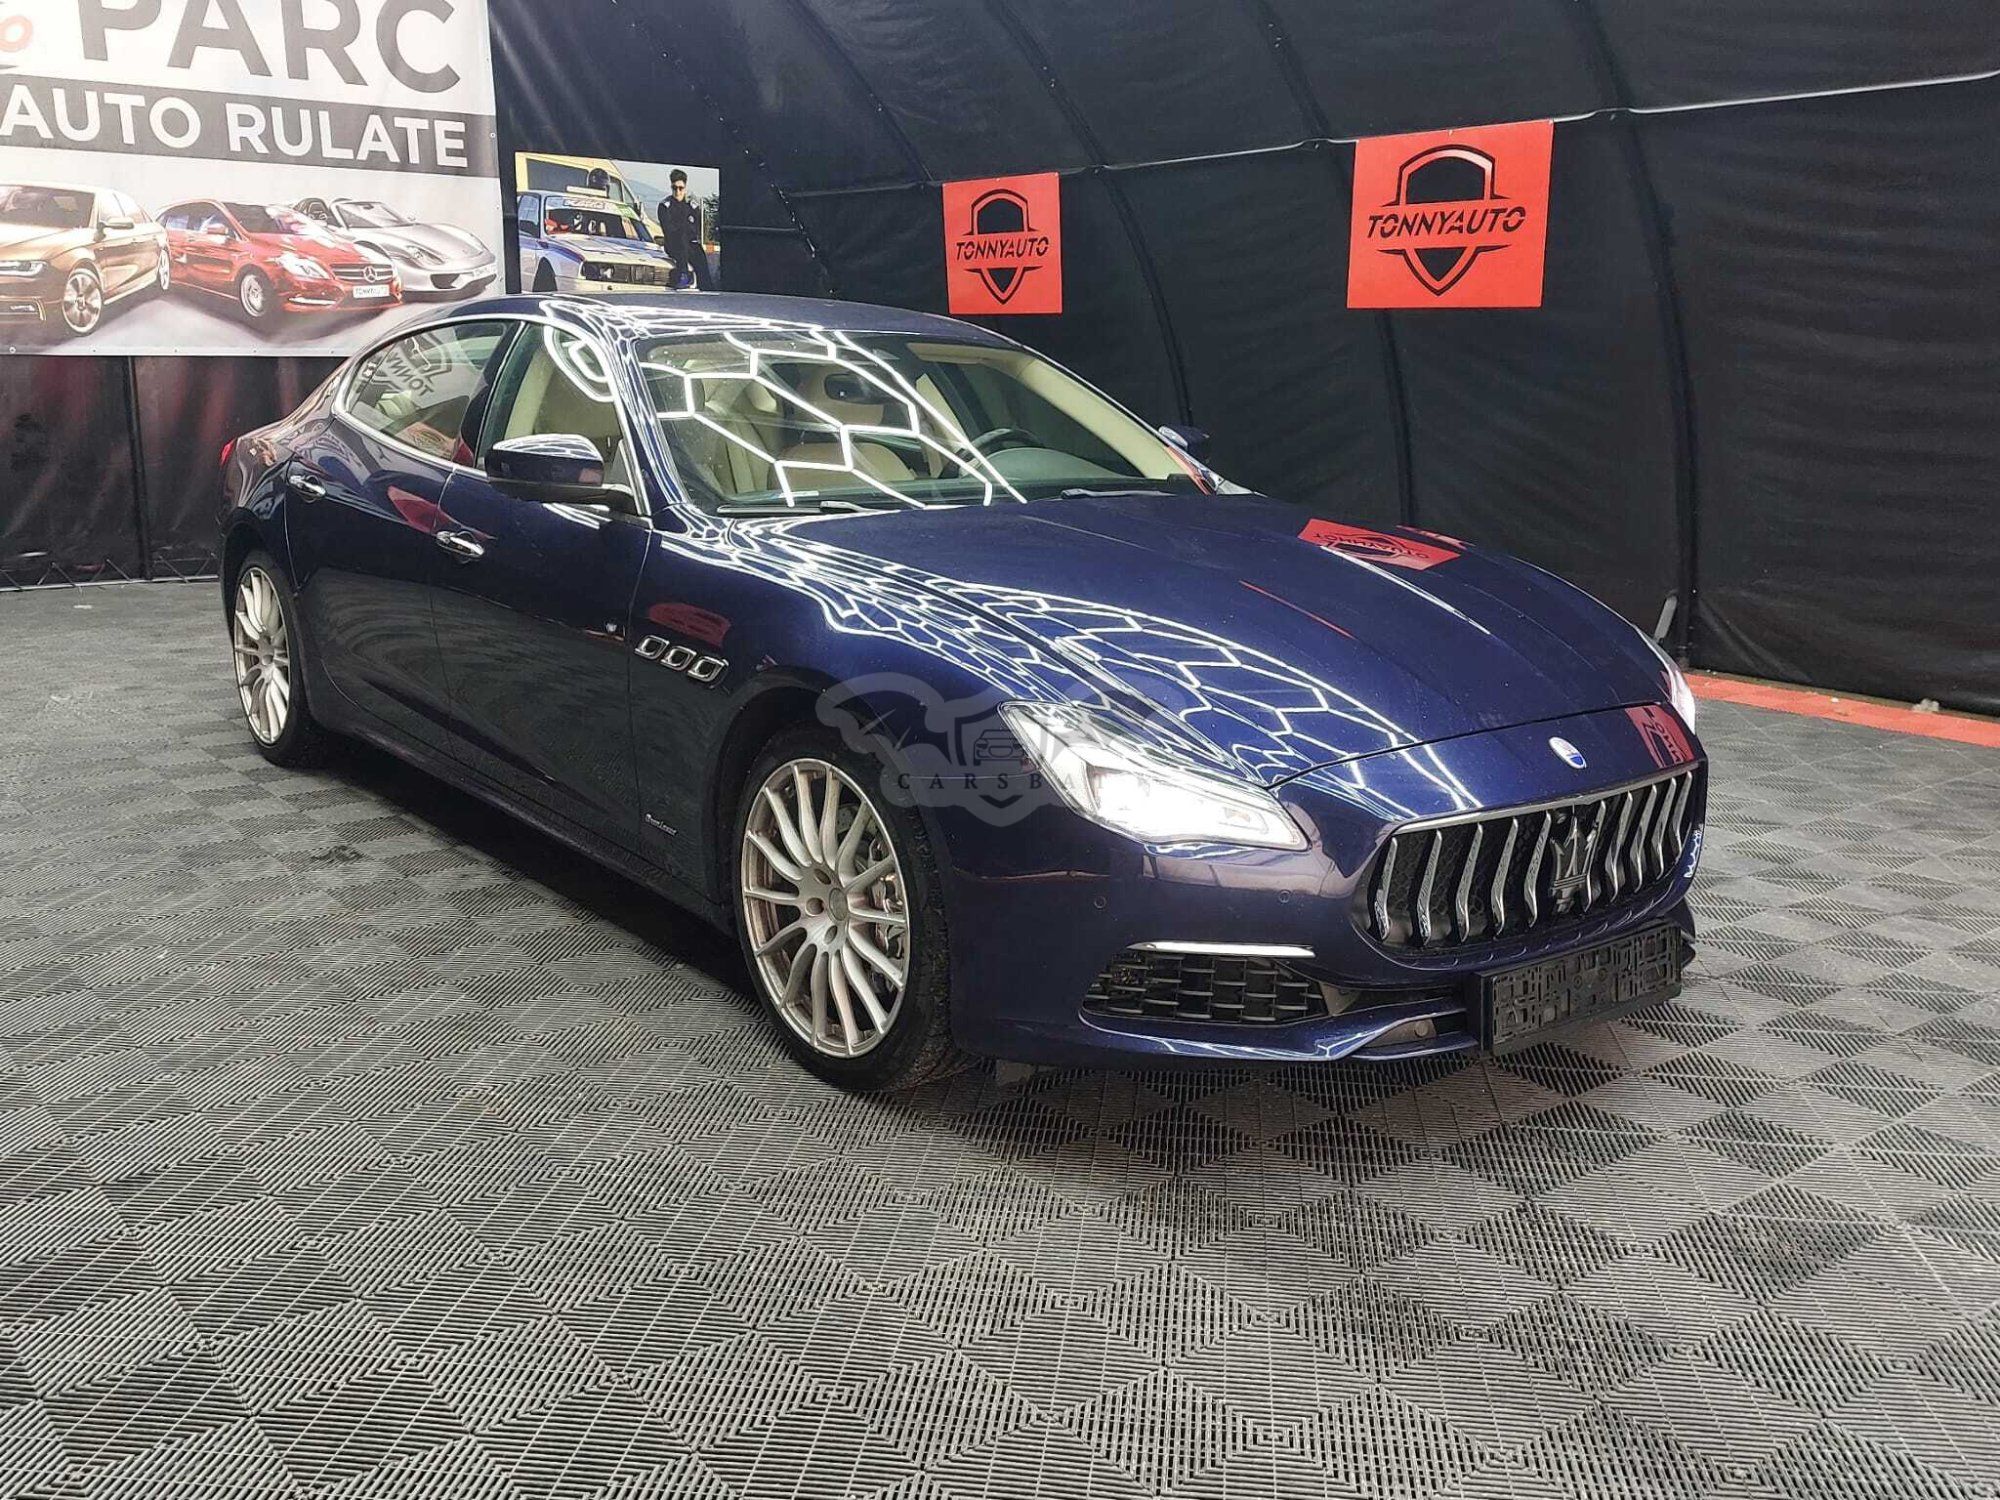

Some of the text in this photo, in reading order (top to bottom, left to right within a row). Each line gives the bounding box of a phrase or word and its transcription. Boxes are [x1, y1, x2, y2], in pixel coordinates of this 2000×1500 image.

[78, 0, 461, 94] PARC
[0, 83, 468, 168] AUTO RULATE
[956, 236, 1049, 261] TONNYAUTO
[1366, 206, 1526, 239] TONNYAUTO
